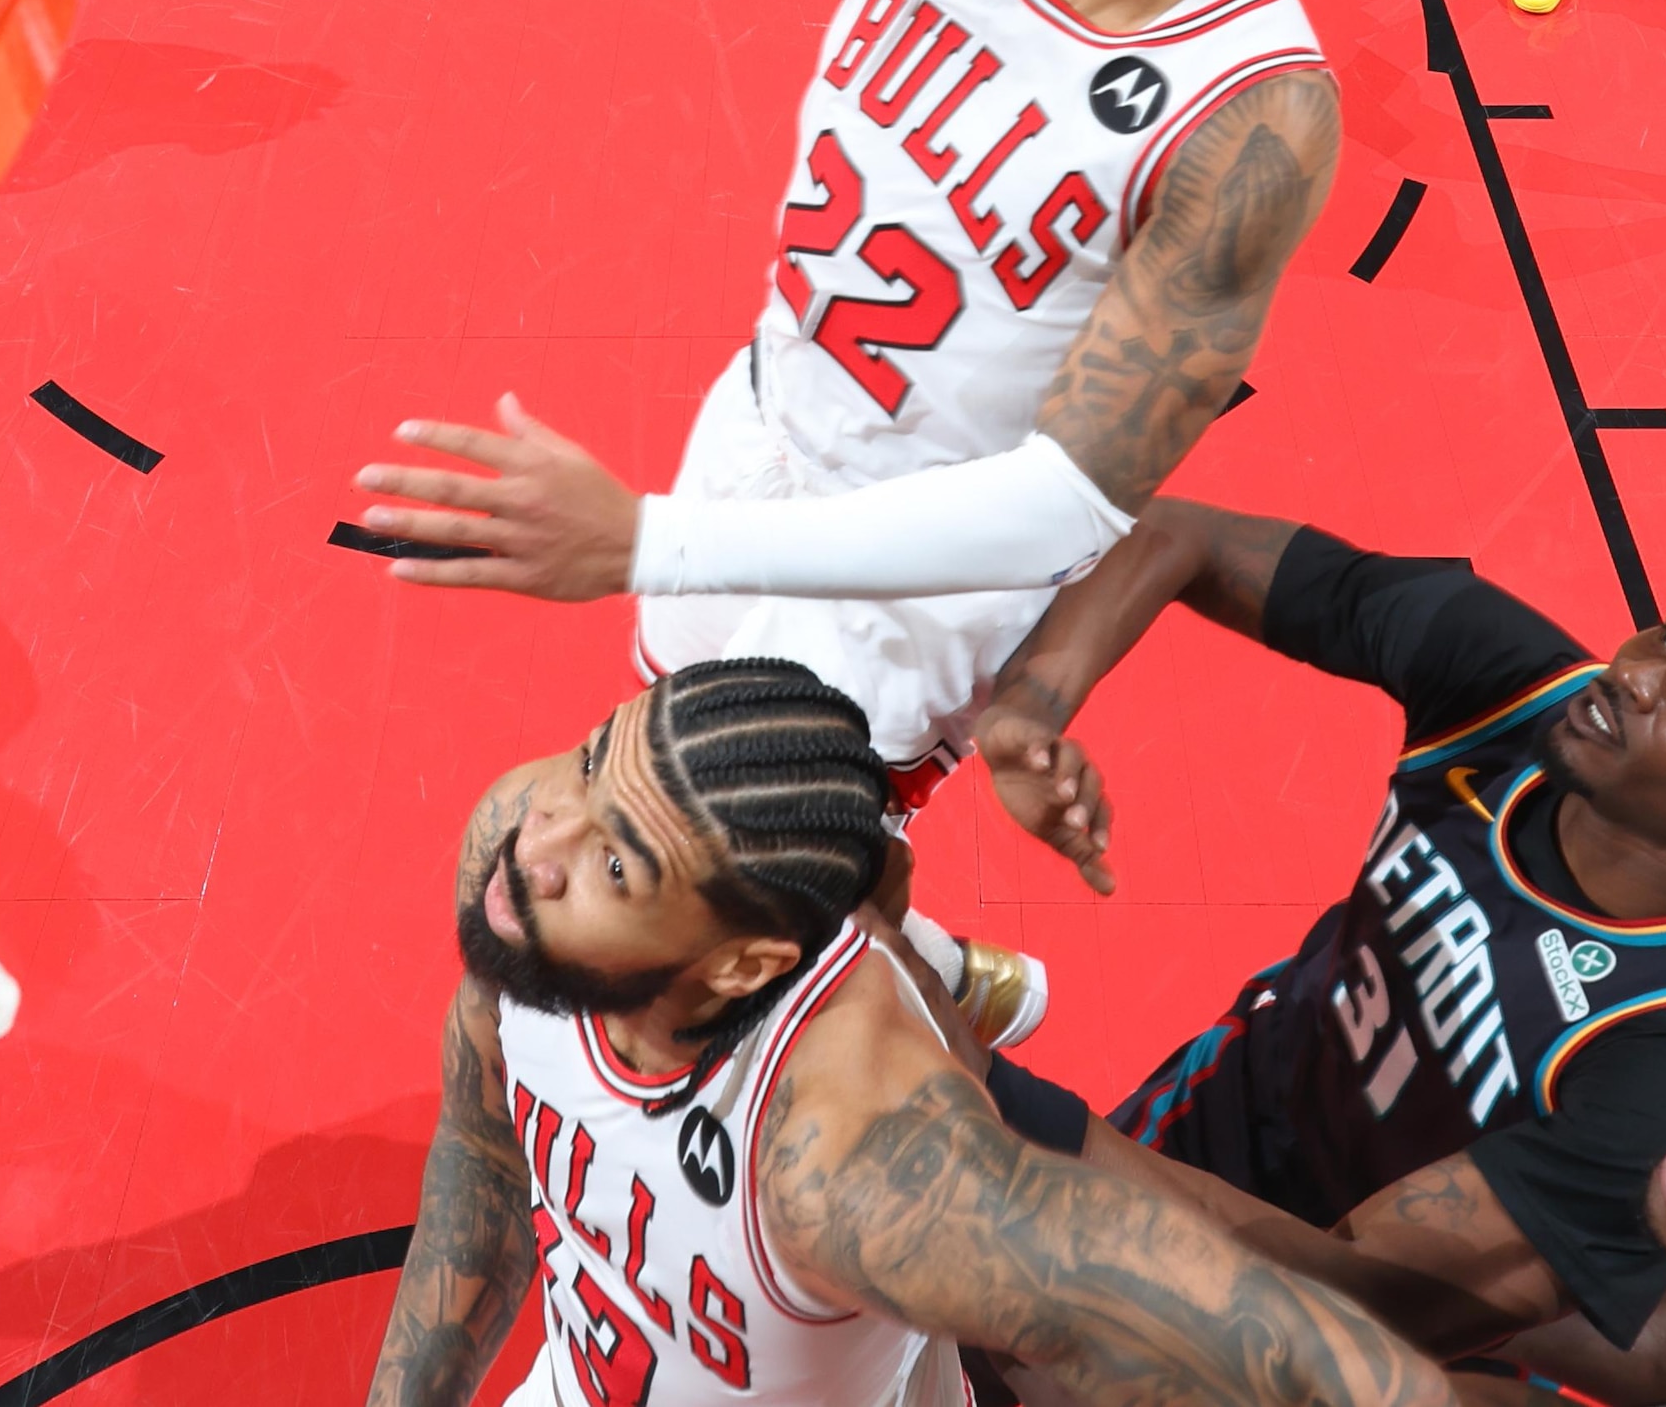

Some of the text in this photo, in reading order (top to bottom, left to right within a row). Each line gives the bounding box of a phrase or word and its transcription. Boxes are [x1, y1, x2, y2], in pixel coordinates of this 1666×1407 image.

[776, 129, 965, 420] 22
[1331, 944, 1420, 1121] 31
[1542, 932, 1587, 1016] StockX
[513, 1080, 751, 1390] ULLS
